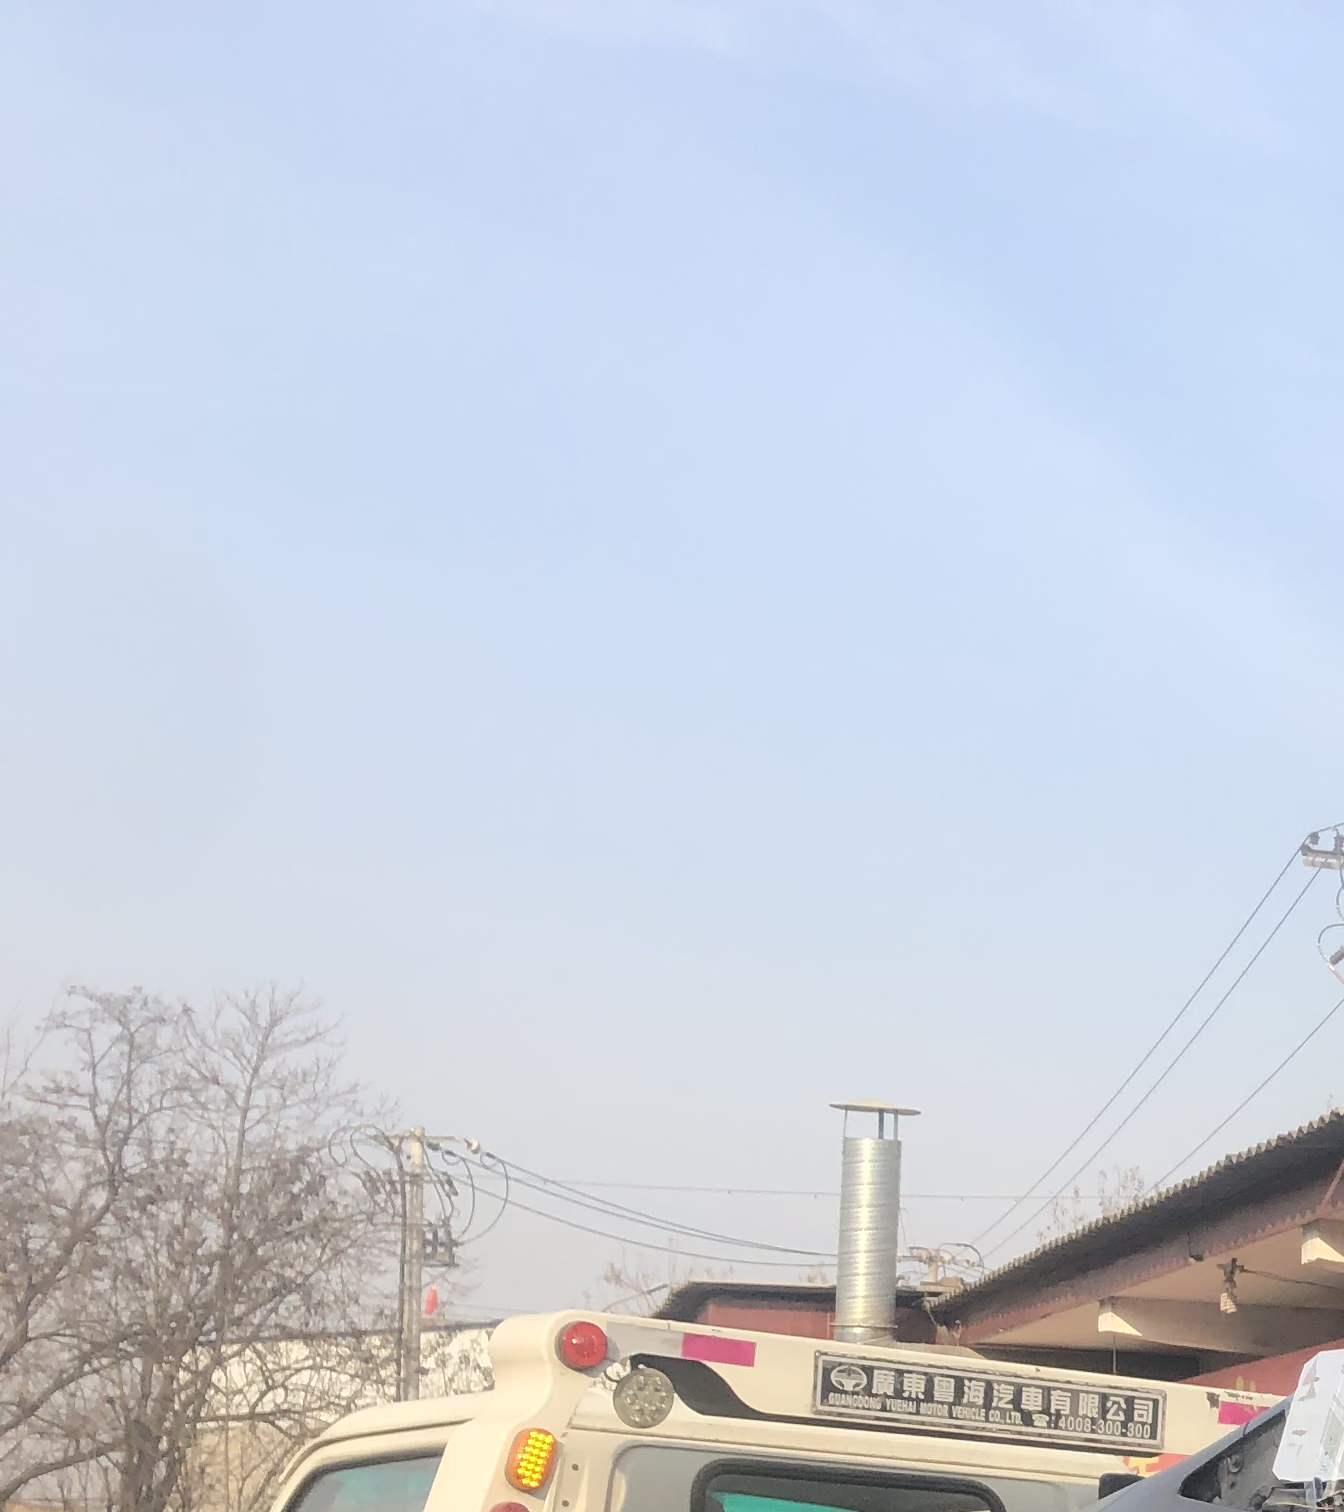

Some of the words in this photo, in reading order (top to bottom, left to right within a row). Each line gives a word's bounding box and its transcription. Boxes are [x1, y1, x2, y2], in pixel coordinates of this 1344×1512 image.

[828, 1392, 881, 1411] GUANGDONG
[885, 1398, 917, 1413] YUEHAI
[920, 1401, 949, 1417] MOTOR
[951, 1405, 986, 1420] VEHICLE
